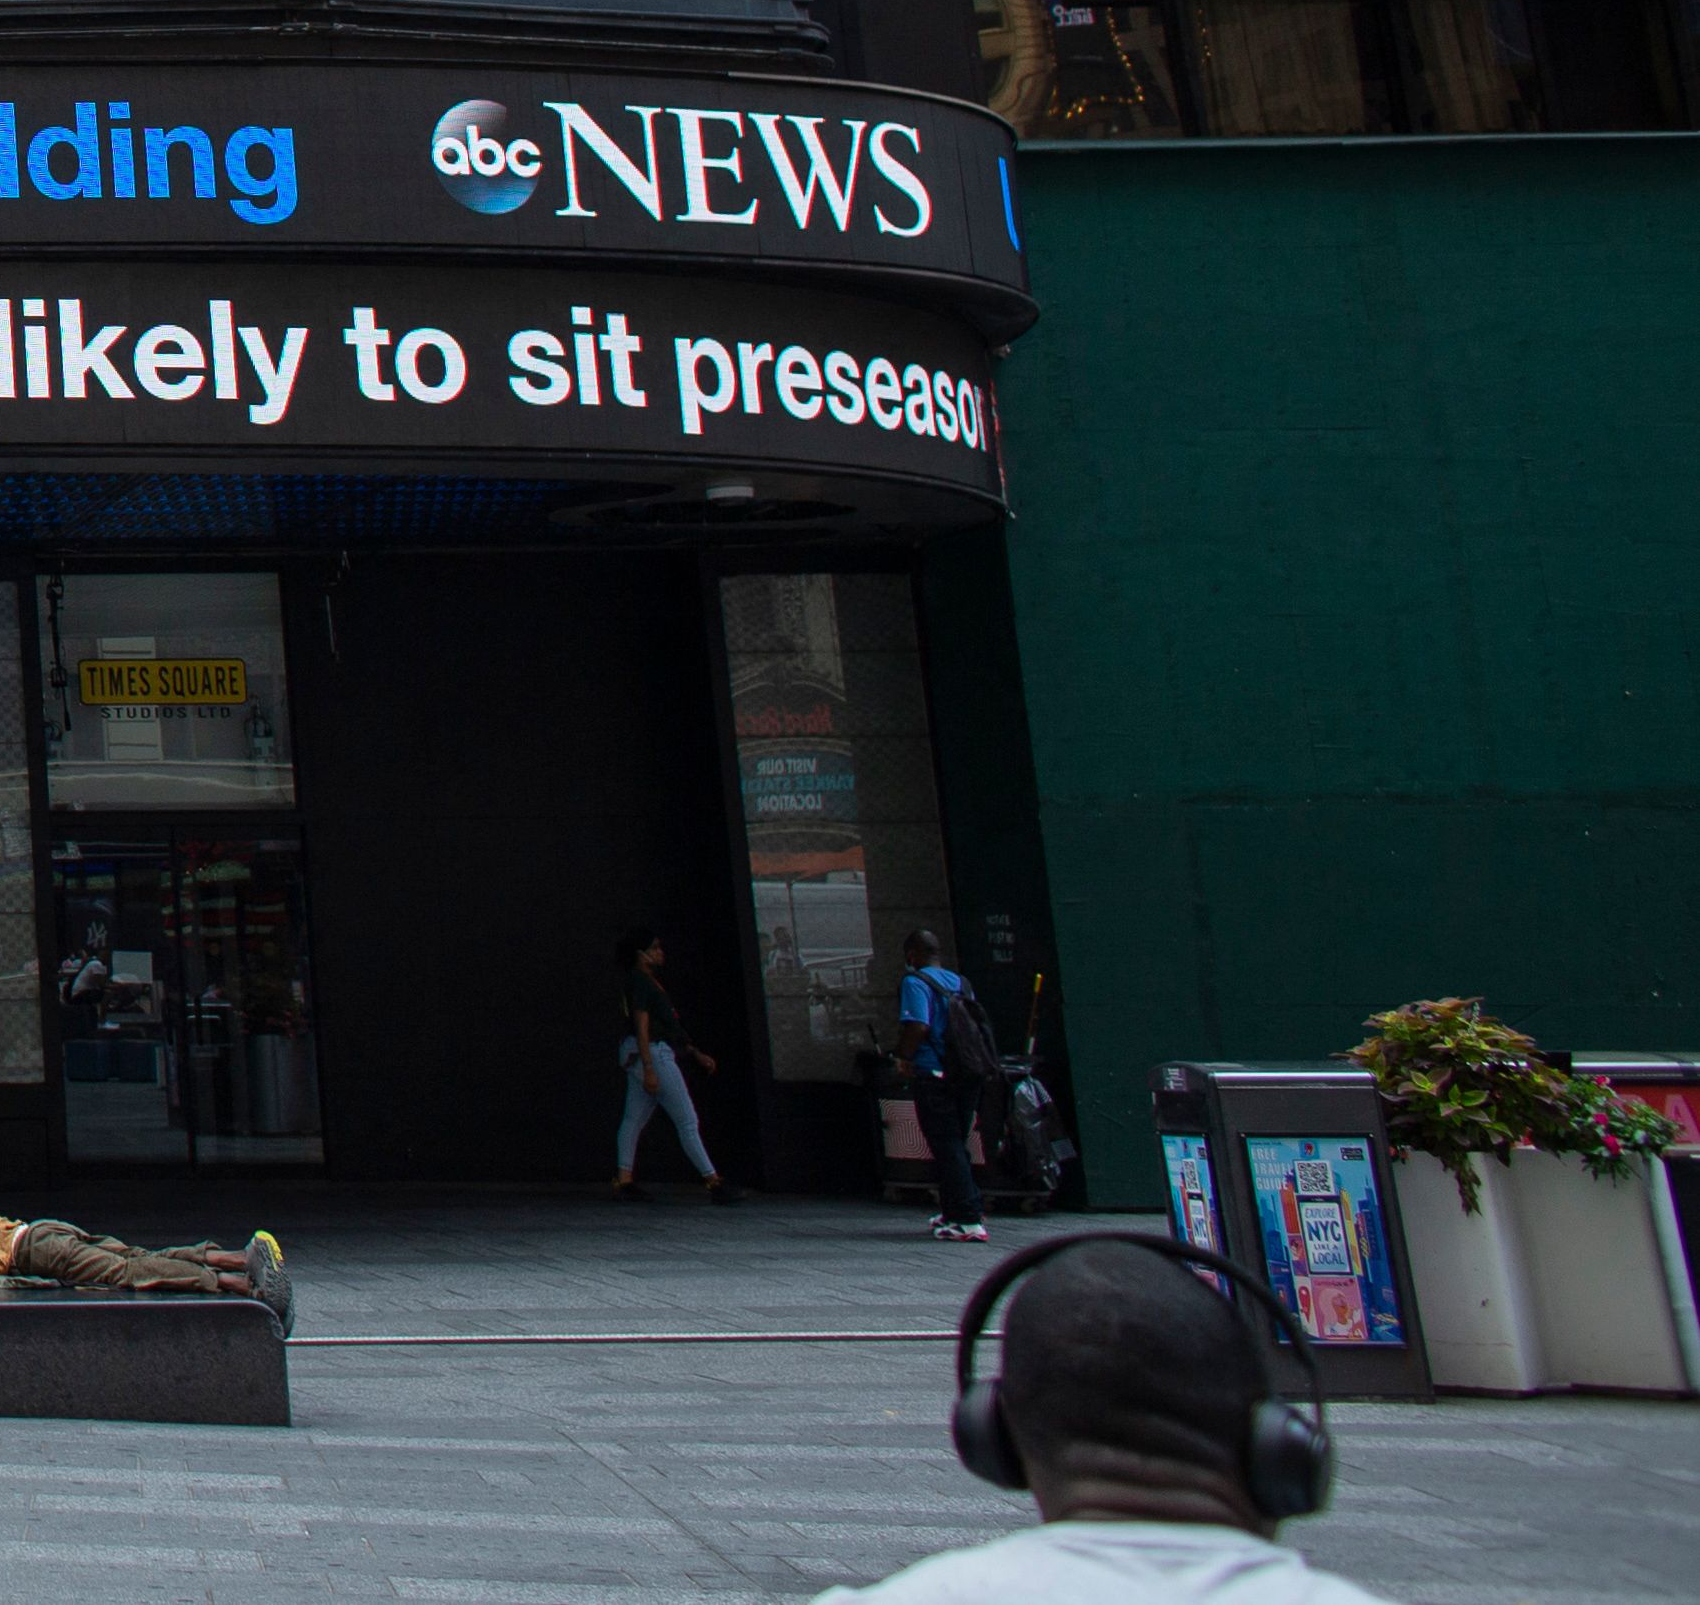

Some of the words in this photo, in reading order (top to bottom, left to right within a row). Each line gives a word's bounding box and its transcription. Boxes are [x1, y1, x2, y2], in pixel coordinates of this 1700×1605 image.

[432, 125, 542, 178] abc
[543, 100, 932, 237] NEWS
[343, 307, 468, 404] to
[507, 305, 648, 408] sit
[87, 666, 151, 696] TIMES
[158, 666, 239, 698] SQUARE
[101, 707, 187, 719] STUDIOS
[198, 707, 231, 719] LTD
[1251, 1147, 1277, 1160] FREE
[1256, 1177, 1288, 1190] GUIDE
[1305, 1207, 1335, 1218] EXPLORE
[1306, 1220, 1342, 1242] NYC
[1312, 1252, 1345, 1265] LOCAL
